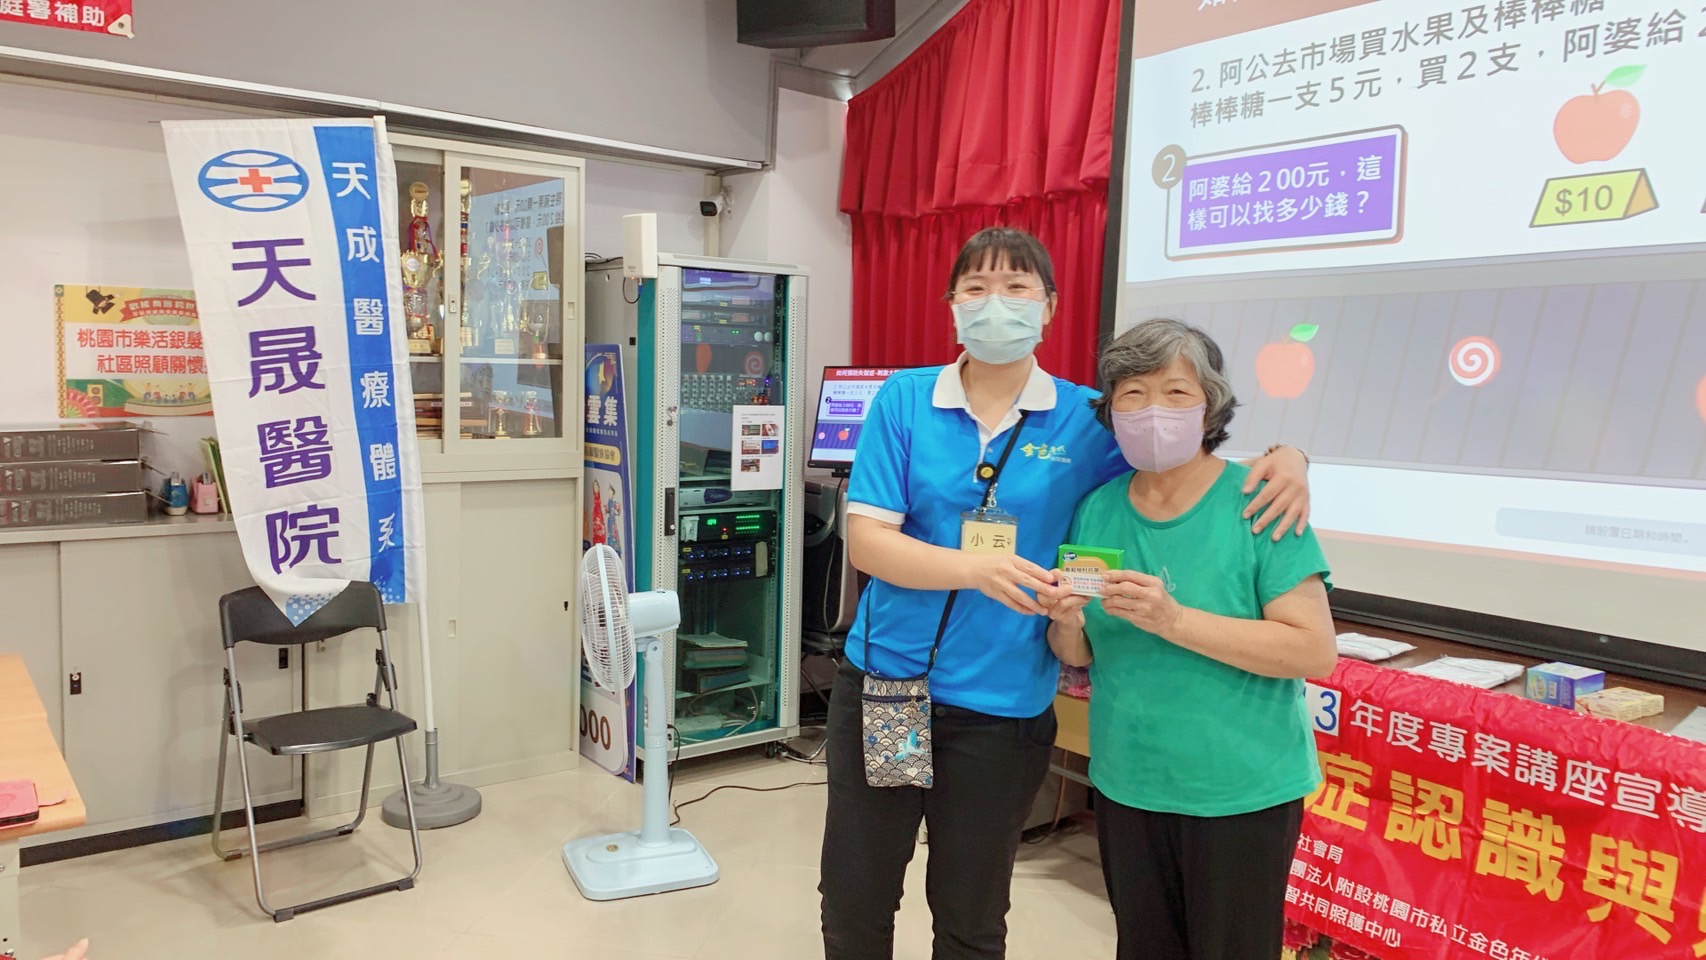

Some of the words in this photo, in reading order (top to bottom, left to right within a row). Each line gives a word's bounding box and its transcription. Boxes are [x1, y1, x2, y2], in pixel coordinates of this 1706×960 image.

[1162, 153, 1176, 183] 2
[1554, 184, 1613, 217] $10
[77, 328, 204, 350] 桃園市樂活銀髮
[332, 162, 397, 553] 天成醫療體系
[97, 354, 208, 374] 社區照顧關懷
[231, 238, 342, 575] 天晟醫院
[586, 394, 618, 427] 雲集
[1303, 687, 1706, 834] 3年度專案講座宣導
[1296, 833, 1344, 865] 社會局
[1303, 750, 1706, 958] 症認識與
[1284, 884, 1402, 948] 智共同照護中心
[1289, 858, 1550, 960] 團法人附設桃園市私立金色年
